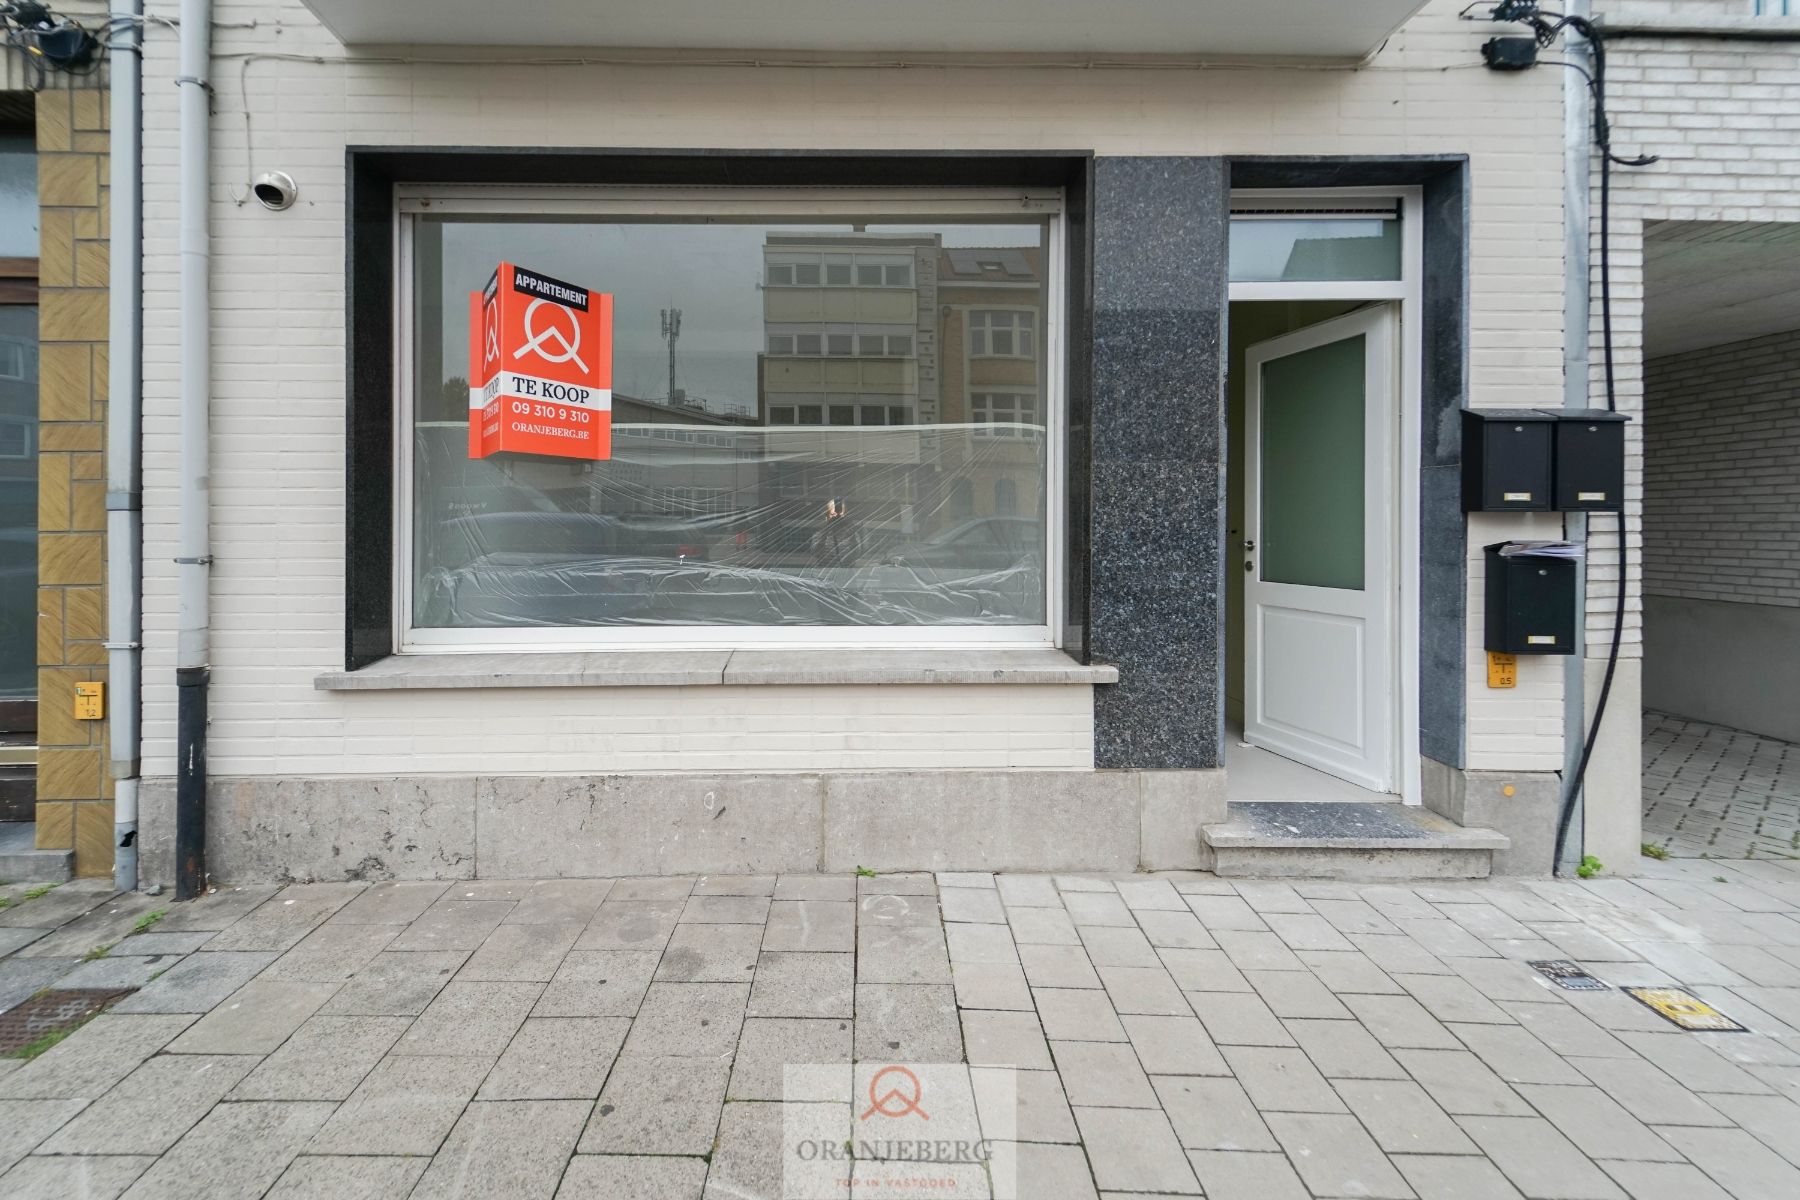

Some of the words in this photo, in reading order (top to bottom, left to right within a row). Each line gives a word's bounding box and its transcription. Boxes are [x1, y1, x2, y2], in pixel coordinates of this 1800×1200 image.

[515, 273, 588, 306] APPARTEMENT
[512, 376, 537, 396] TE
[542, 384, 590, 404] KOOP
[512, 401, 530, 414] 09
[534, 405, 555, 419] 310
[559, 409, 567, 420] 9
[570, 411, 590, 423] 310
[511, 422, 590, 440] ORANJEBERG.BE
